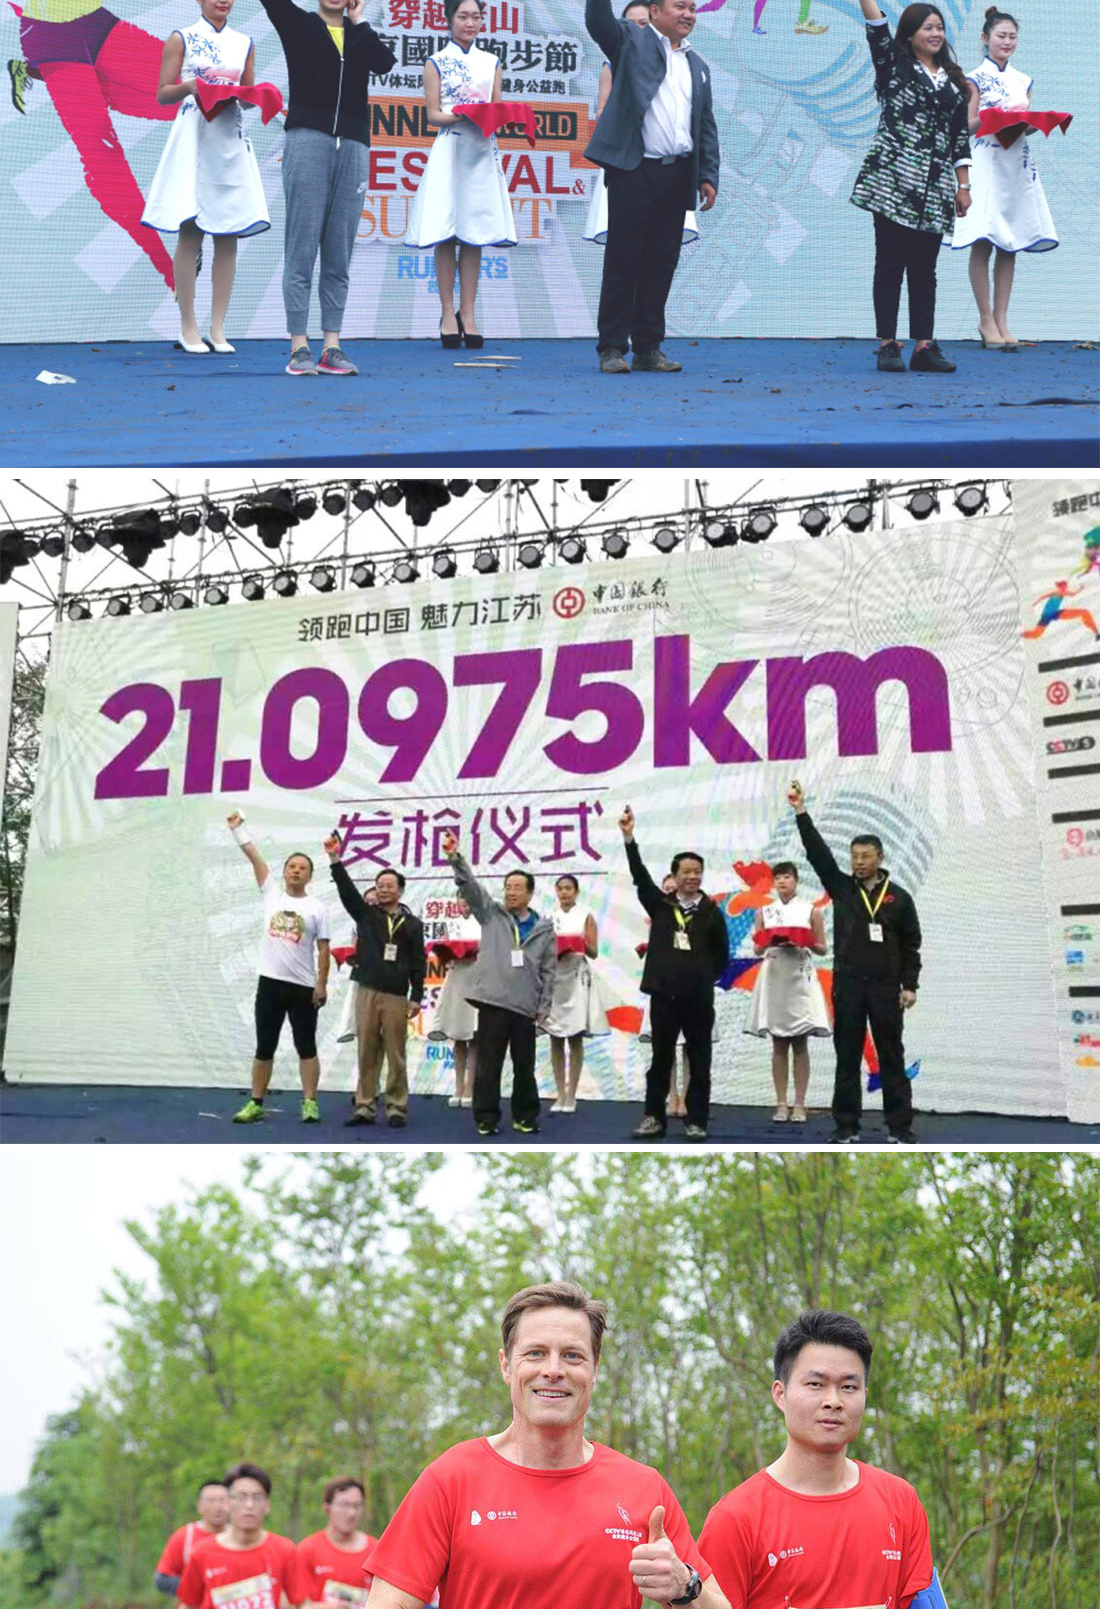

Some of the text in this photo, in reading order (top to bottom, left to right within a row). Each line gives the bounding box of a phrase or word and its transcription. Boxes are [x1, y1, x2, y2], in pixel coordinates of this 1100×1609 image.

[299, 608, 409, 642] 领跑中国
[421, 594, 541, 630] 魅力江苏
[593, 602, 670, 616] BANK OF CHINA
[94, 633, 952, 800] 21.0975km
[339, 800, 602, 869] 发枪仪式
